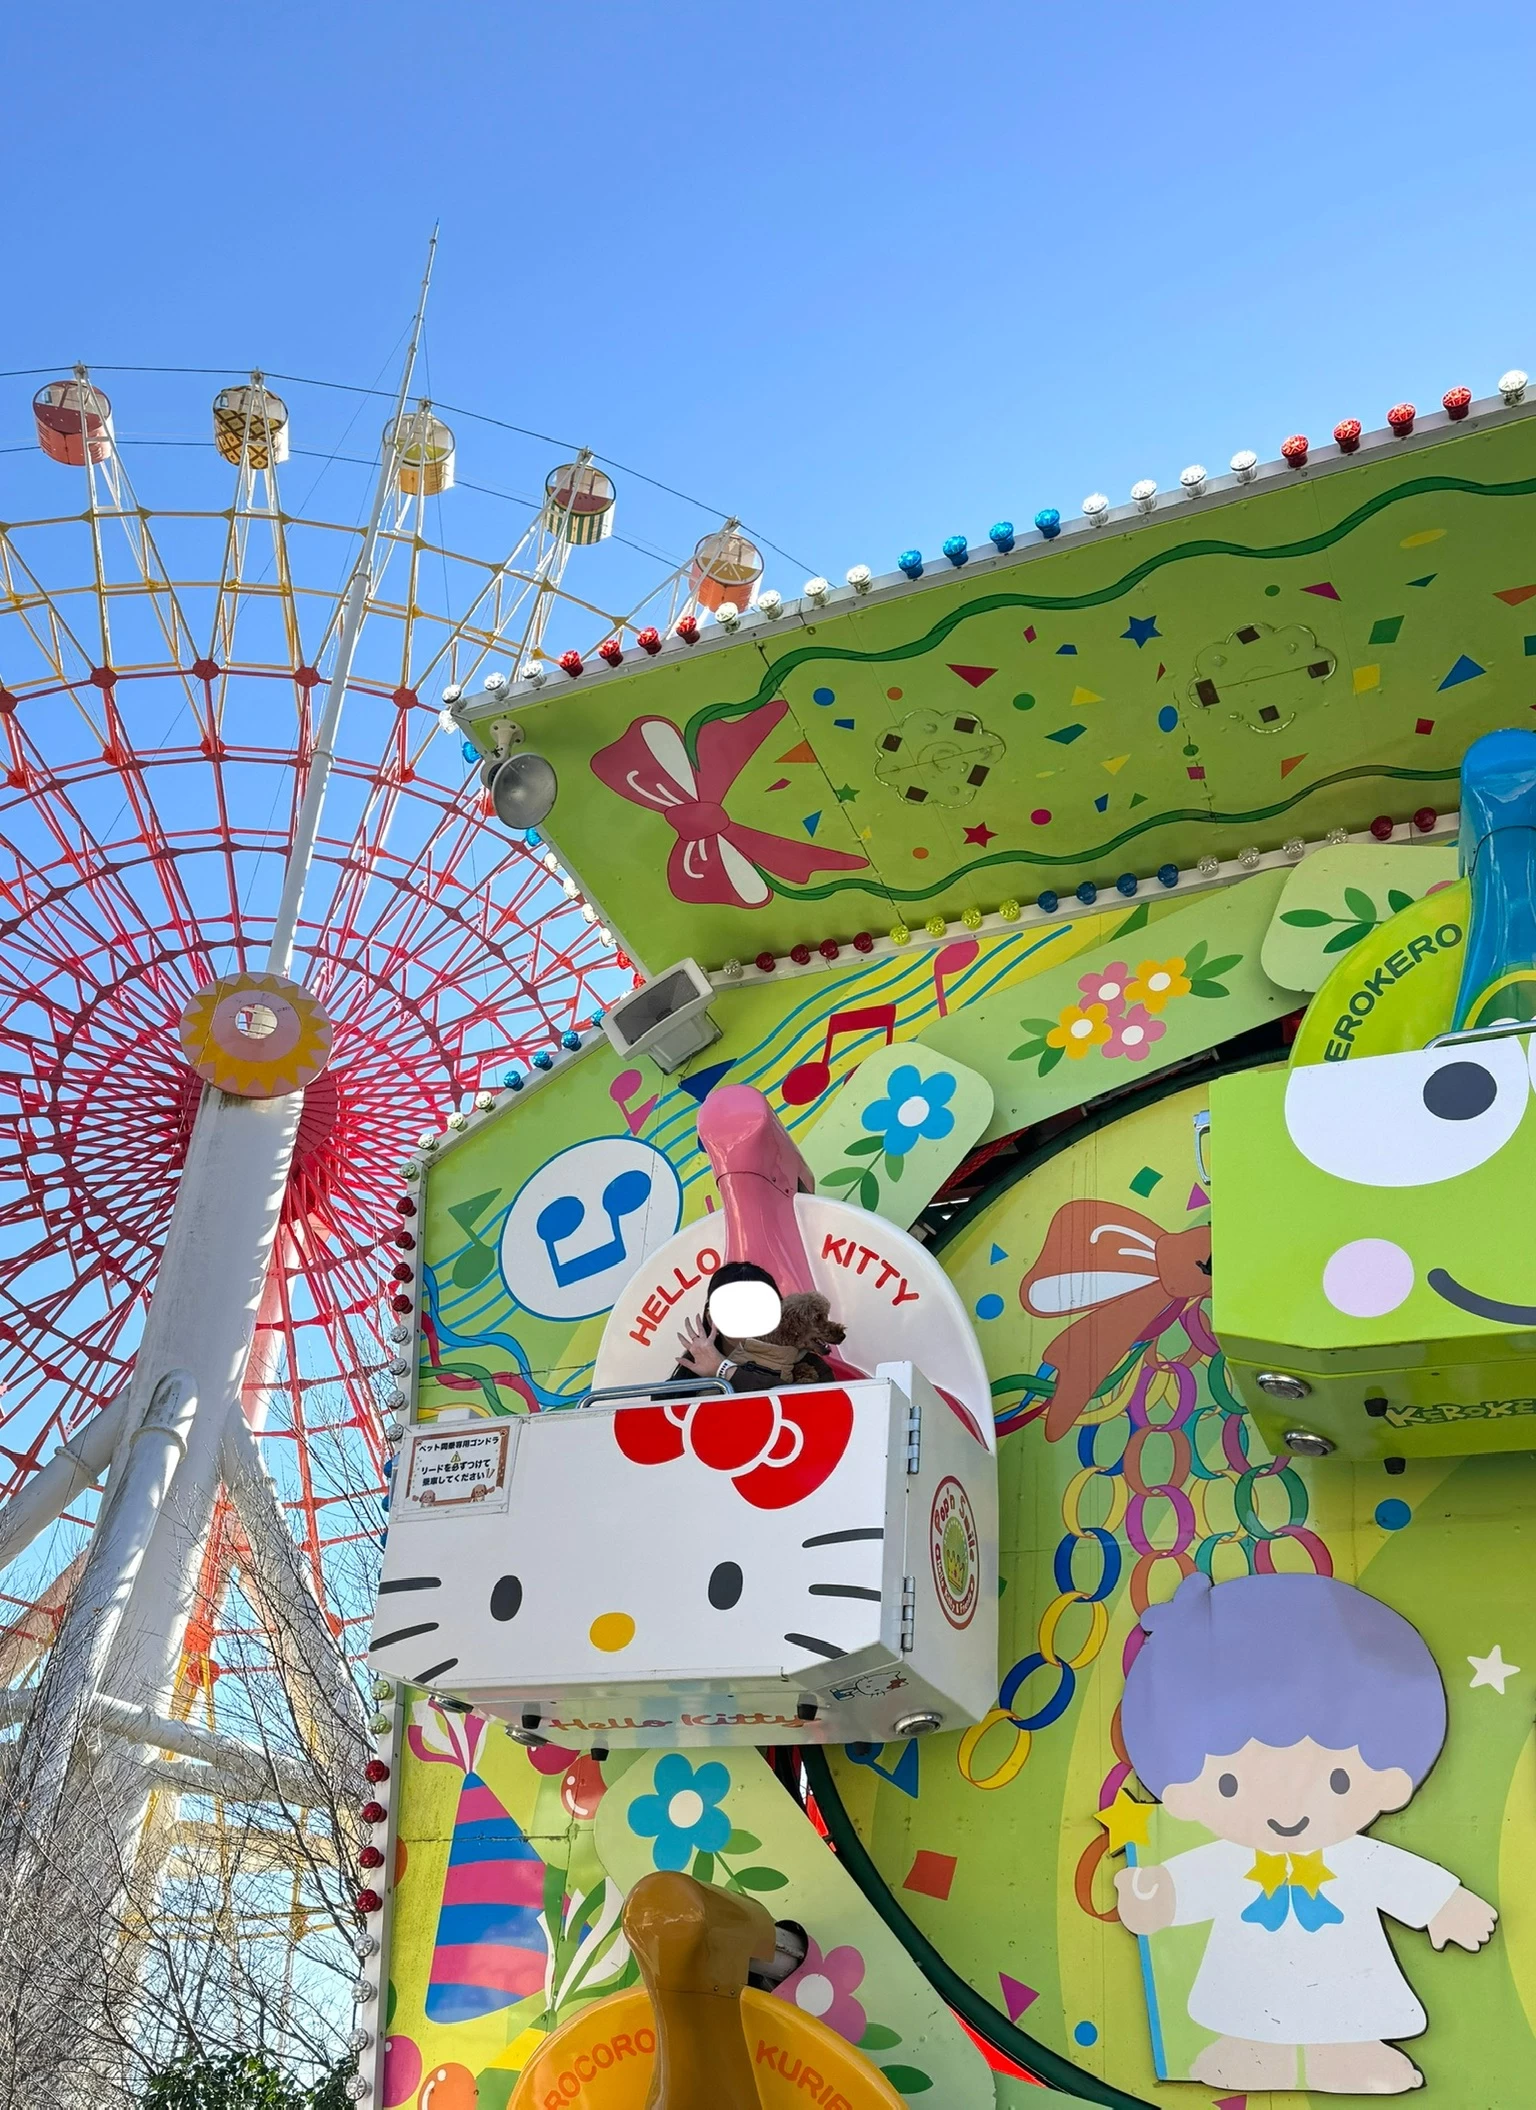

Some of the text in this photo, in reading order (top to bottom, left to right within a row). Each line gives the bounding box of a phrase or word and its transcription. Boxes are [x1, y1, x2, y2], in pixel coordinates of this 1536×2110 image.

[629, 1233, 920, 1347] HELLO KITTY
[421, 1459, 490, 1475] リードを必ずつけて
[549, 1713, 822, 1731] Hello Kitty
